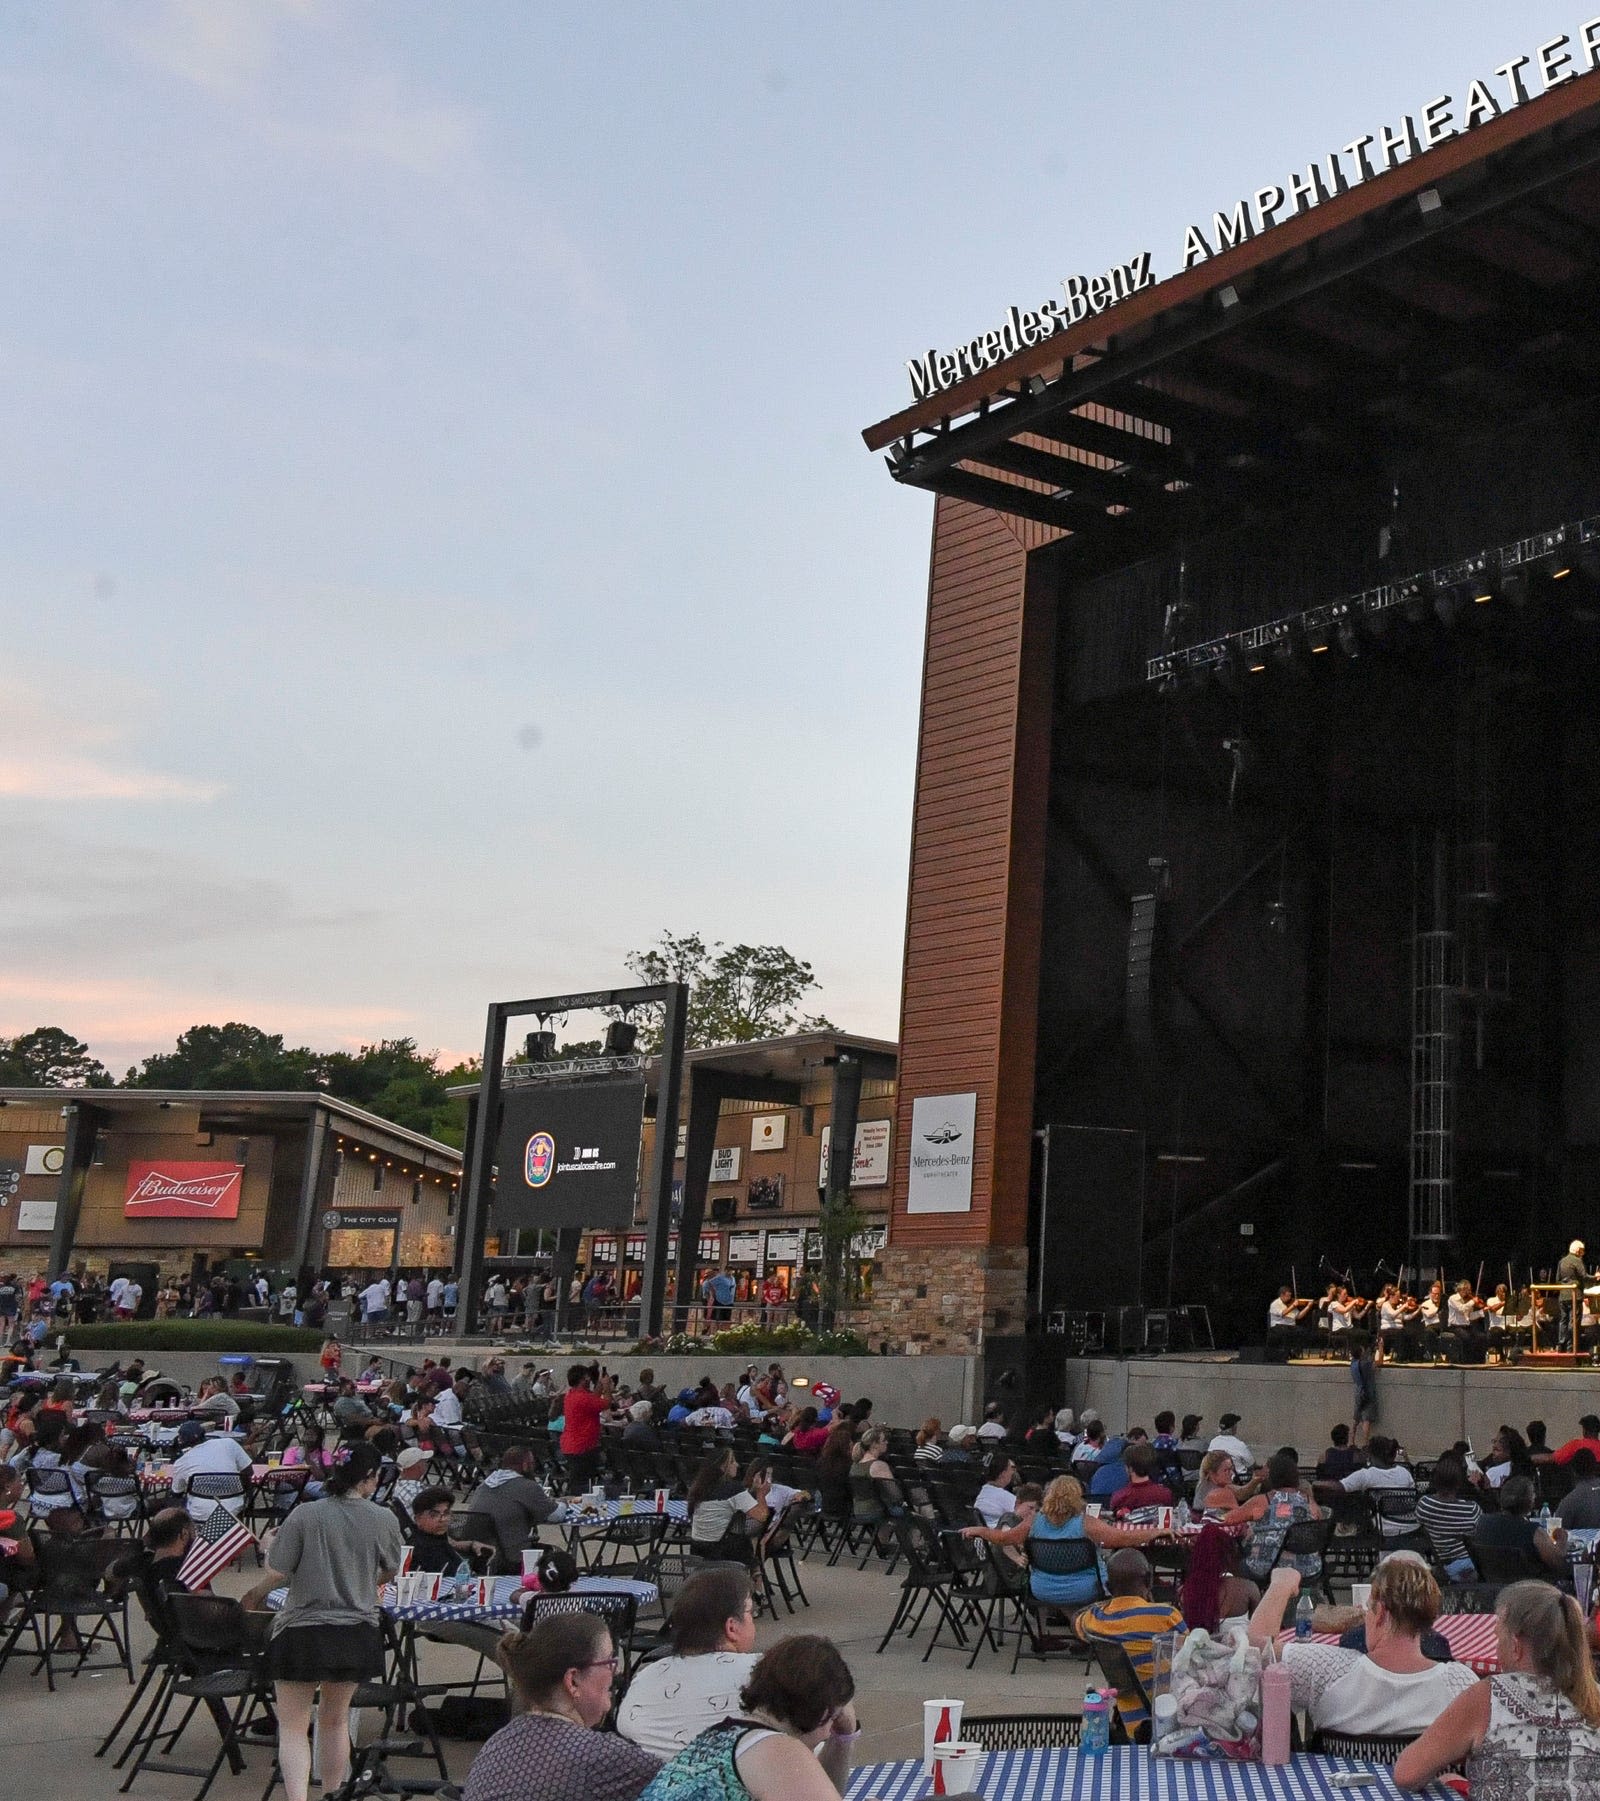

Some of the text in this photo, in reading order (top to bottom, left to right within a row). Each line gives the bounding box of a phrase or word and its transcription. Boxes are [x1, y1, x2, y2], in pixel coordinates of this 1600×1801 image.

[905, 252, 1152, 403] Mercedes-Benz
[558, 994, 603, 1008] NO SMOKING
[718, 1149, 732, 1159] BUD
[912, 1153, 970, 1168] Mercedes-Benz
[556, 1161, 616, 1173] jointuscaloosafire.com
[714, 1158, 733, 1169] LIGHT
[138, 1179, 226, 1197] Budweiser
